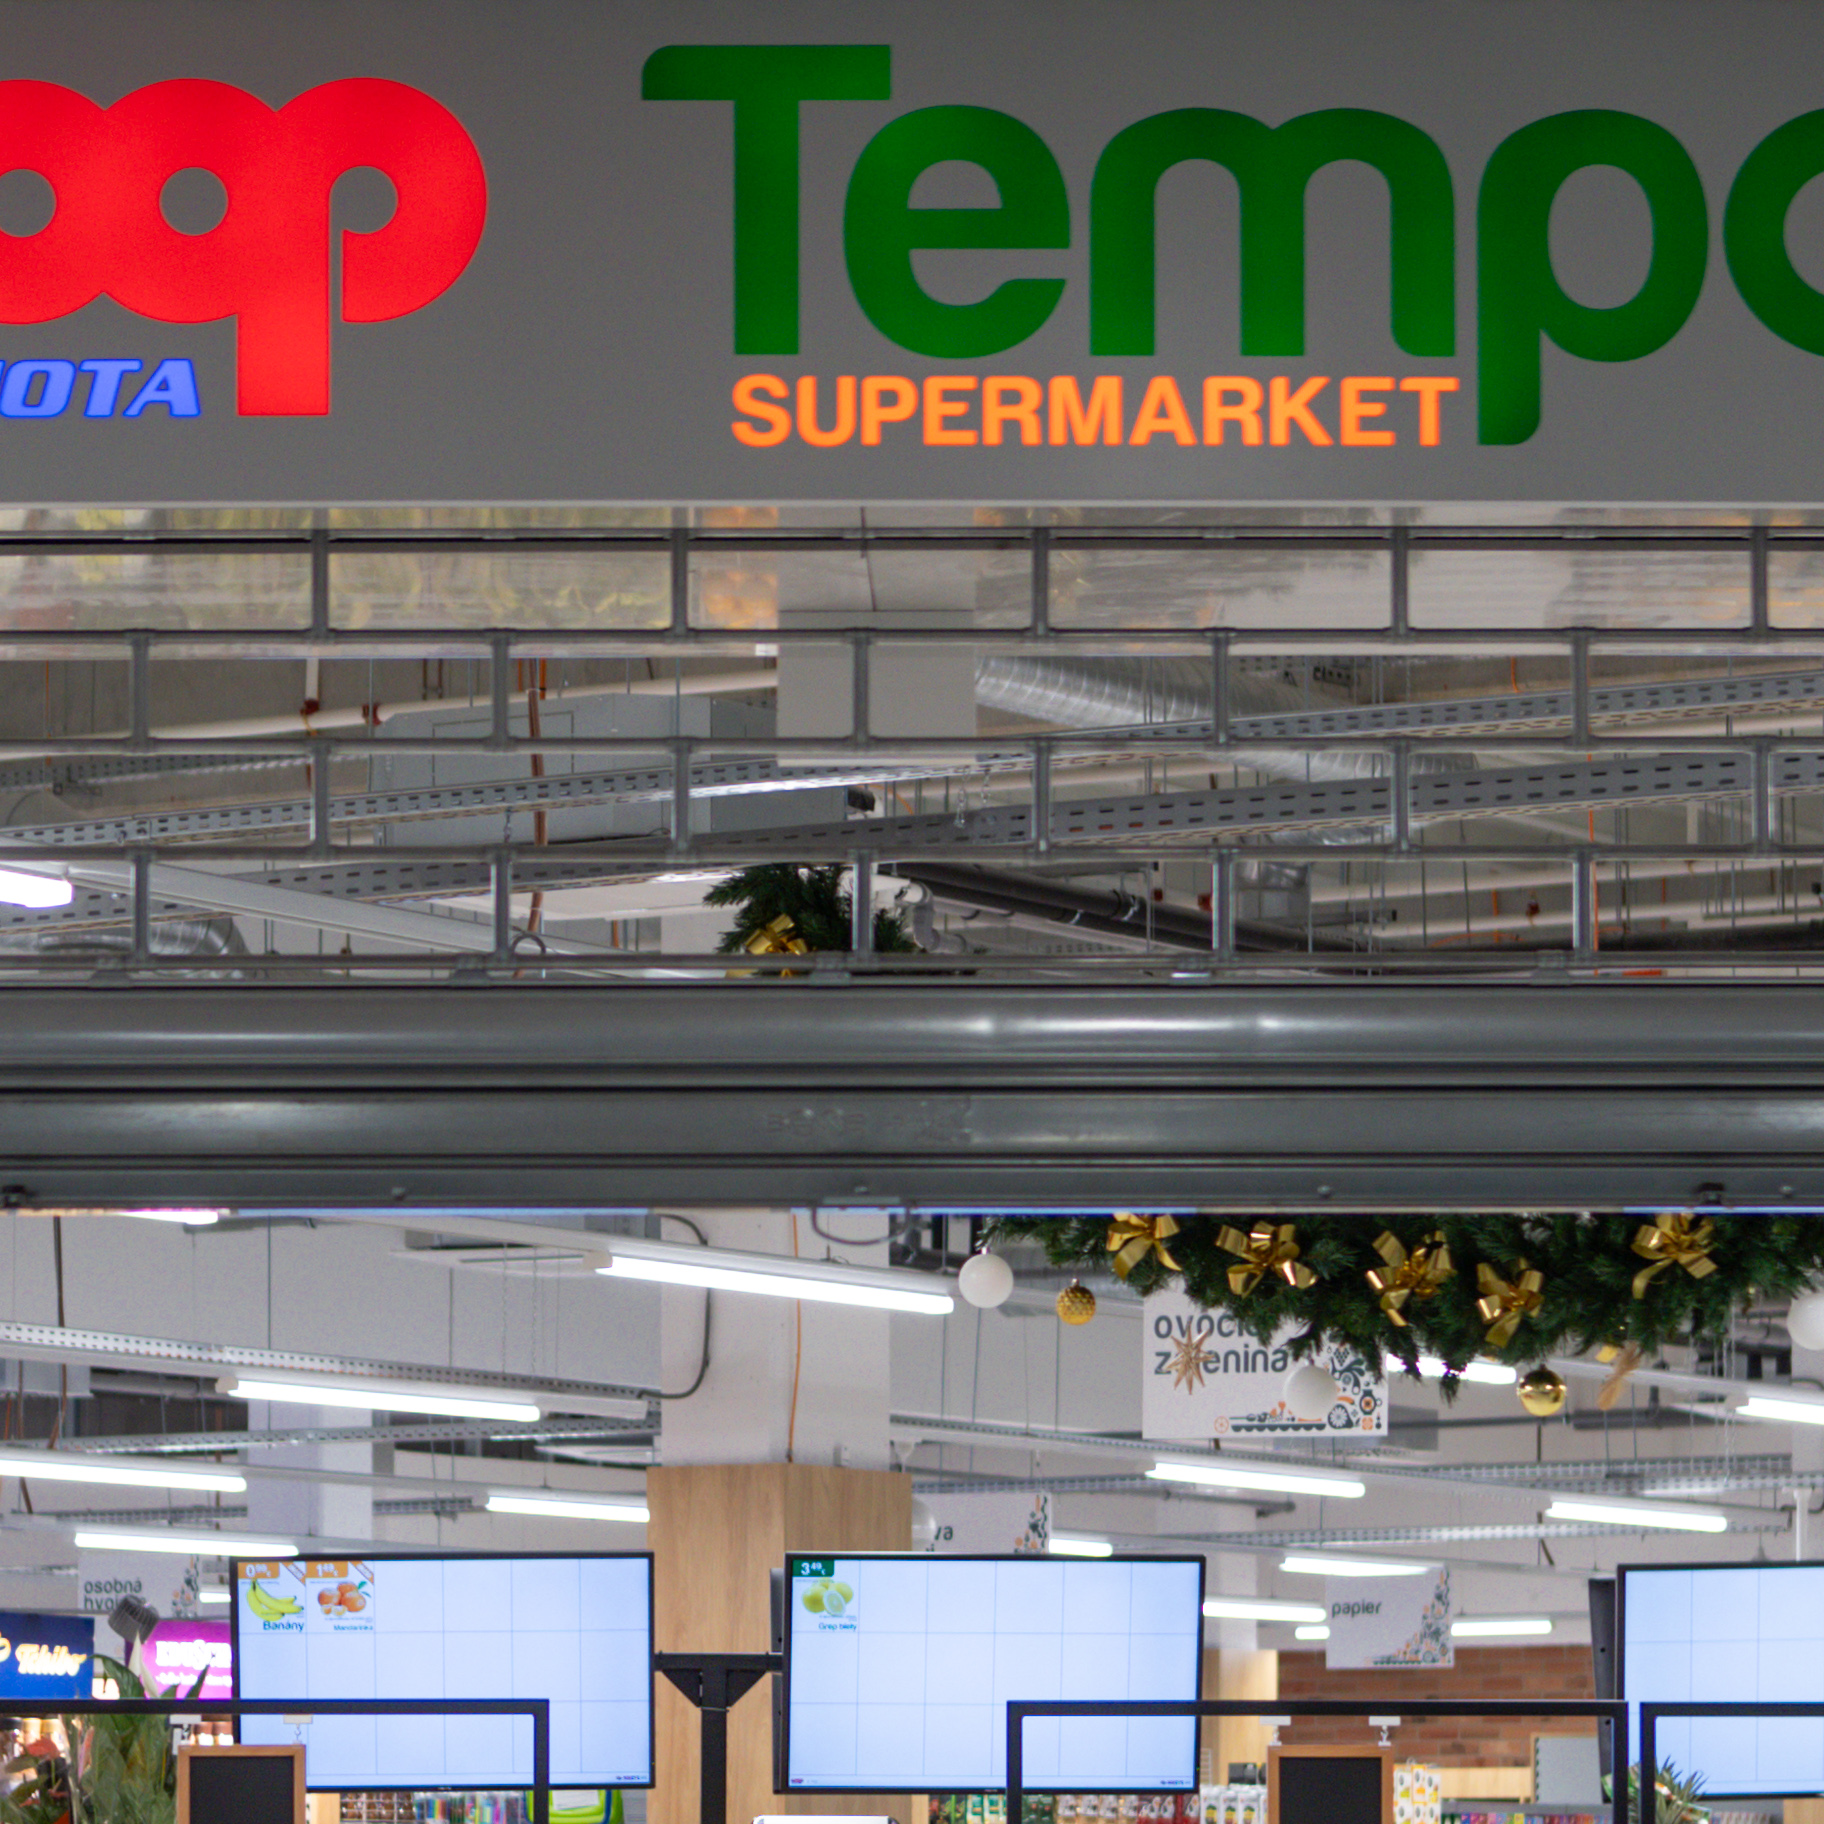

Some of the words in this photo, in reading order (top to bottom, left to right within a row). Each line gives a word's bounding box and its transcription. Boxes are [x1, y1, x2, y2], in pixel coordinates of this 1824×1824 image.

[731, 373, 1461, 448] SUPERMARKET
[1154, 1343, 1289, 1375] zenina
[84, 1577, 143, 1594] osobná
[1331, 1599, 1382, 1619] papier
[14, 1643, 88, 1677] Tchibo
